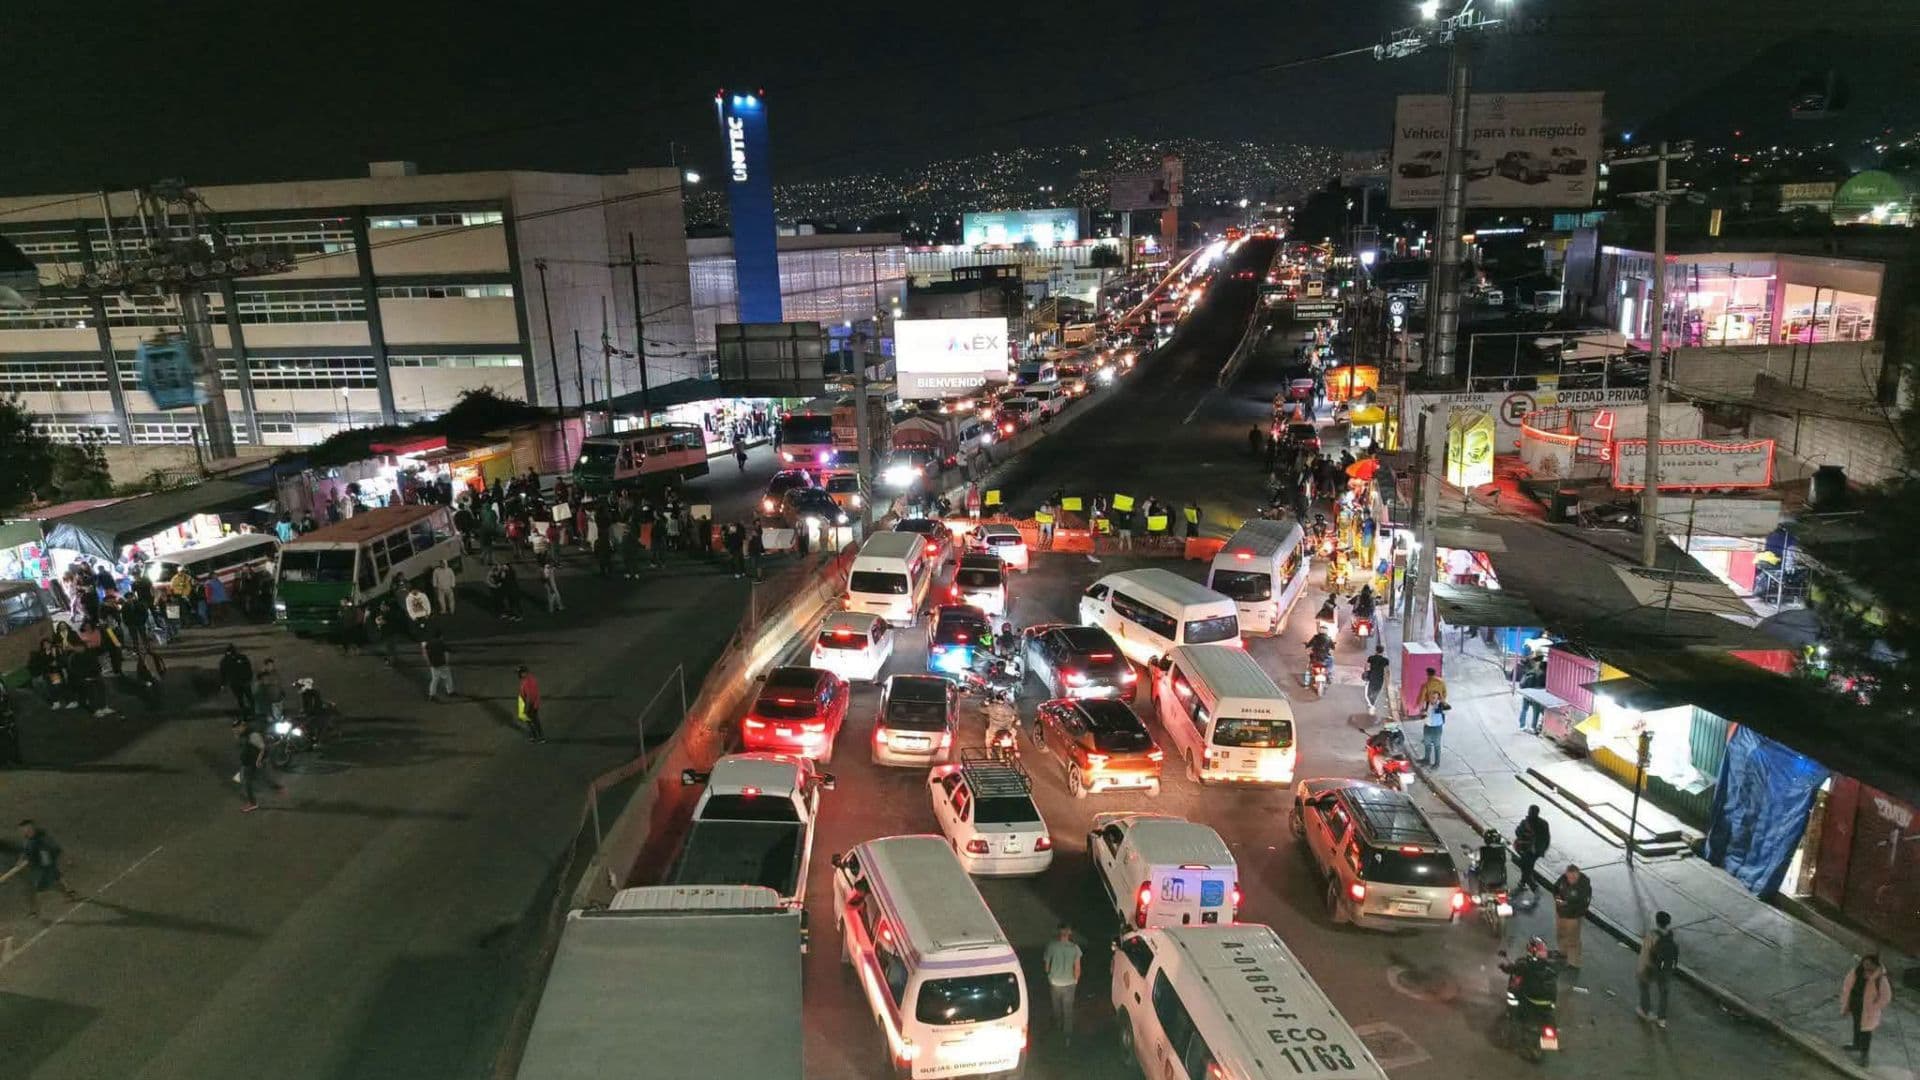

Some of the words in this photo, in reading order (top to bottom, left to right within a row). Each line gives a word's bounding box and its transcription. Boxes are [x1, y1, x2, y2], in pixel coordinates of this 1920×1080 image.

[1473, 127, 1505, 141] para
[1510, 126, 1525, 137] tu
[1529, 123, 1587, 138] negocio
[728, 117, 747, 181] UNITEC
[917, 376, 987, 388] BIENVENIDO
[1607, 388, 1650, 401] PRIVAD
[1266, 1027, 1328, 1045] ECO
[1280, 1044, 1356, 1074] 1763
